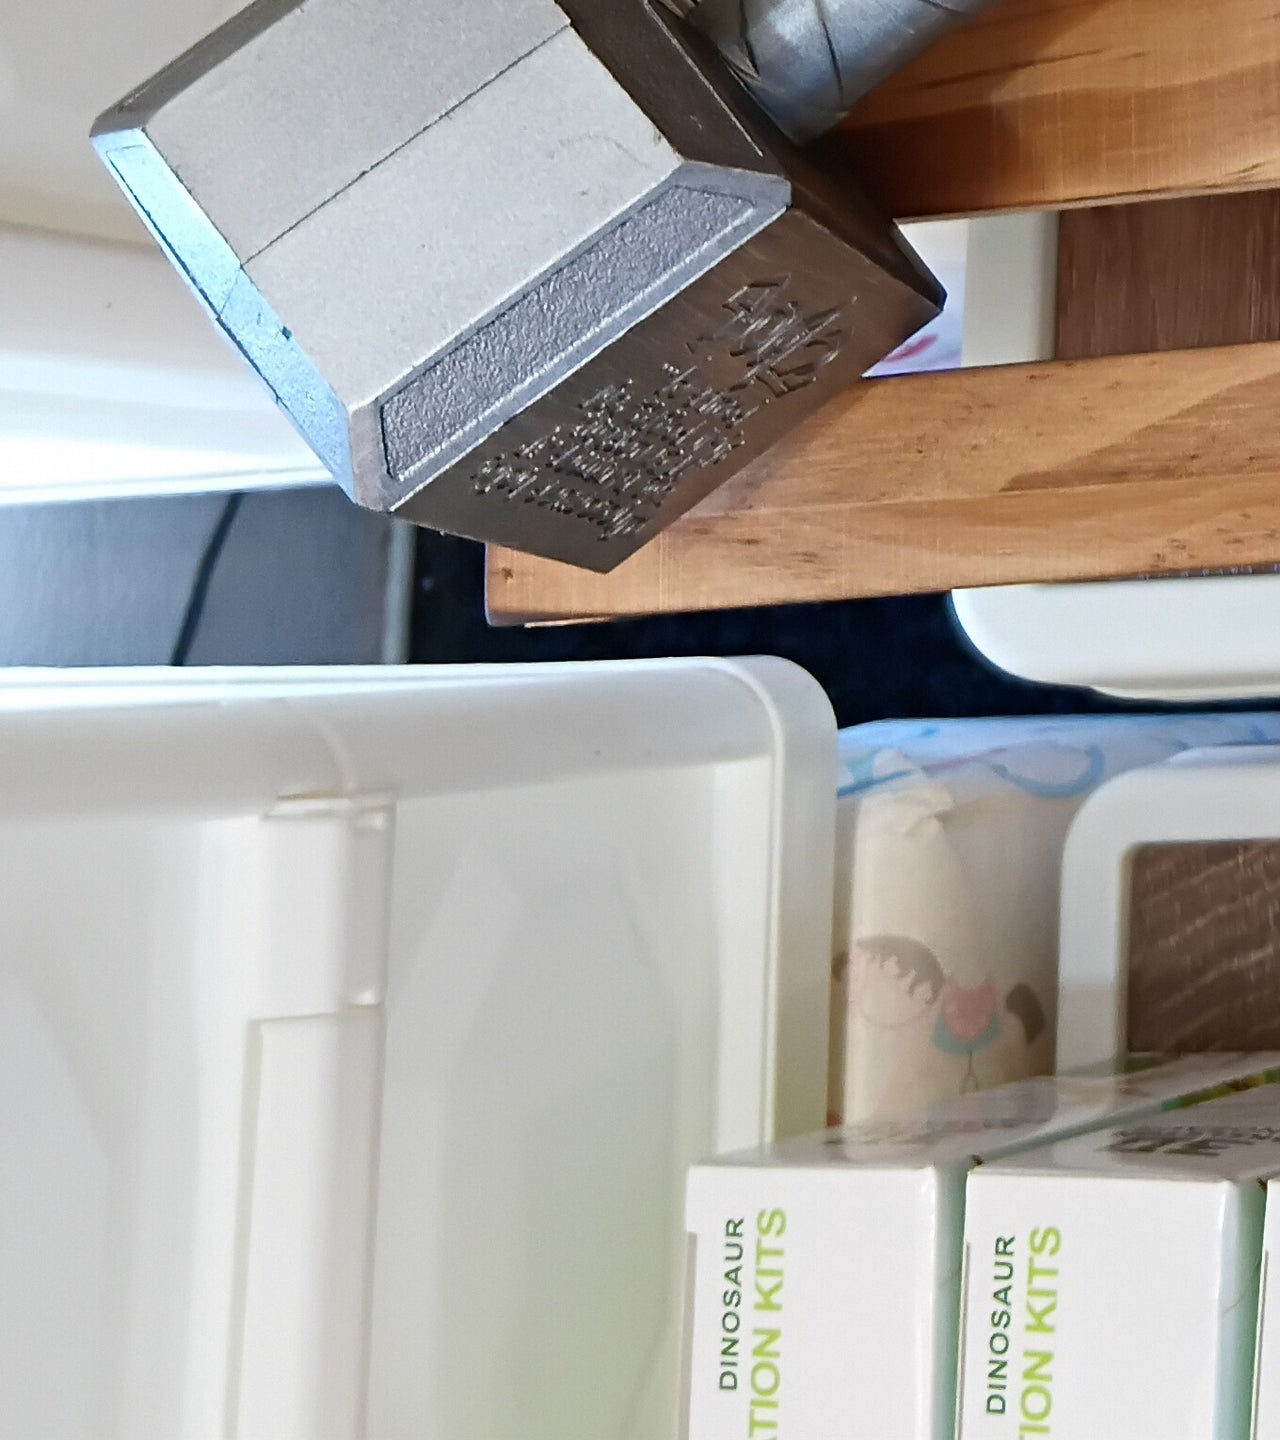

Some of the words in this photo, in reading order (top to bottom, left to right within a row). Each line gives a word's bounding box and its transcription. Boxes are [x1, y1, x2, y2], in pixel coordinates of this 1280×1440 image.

[718, 1217, 744, 1391] DINOSAUR
[753, 1209, 787, 1313] KITS
[1023, 1226, 1062, 1335] KITS
[985, 1235, 1016, 1415] DINOSAUR
[748, 1328, 781, 1440] TION
[1018, 1350, 1054, 1440] ION
